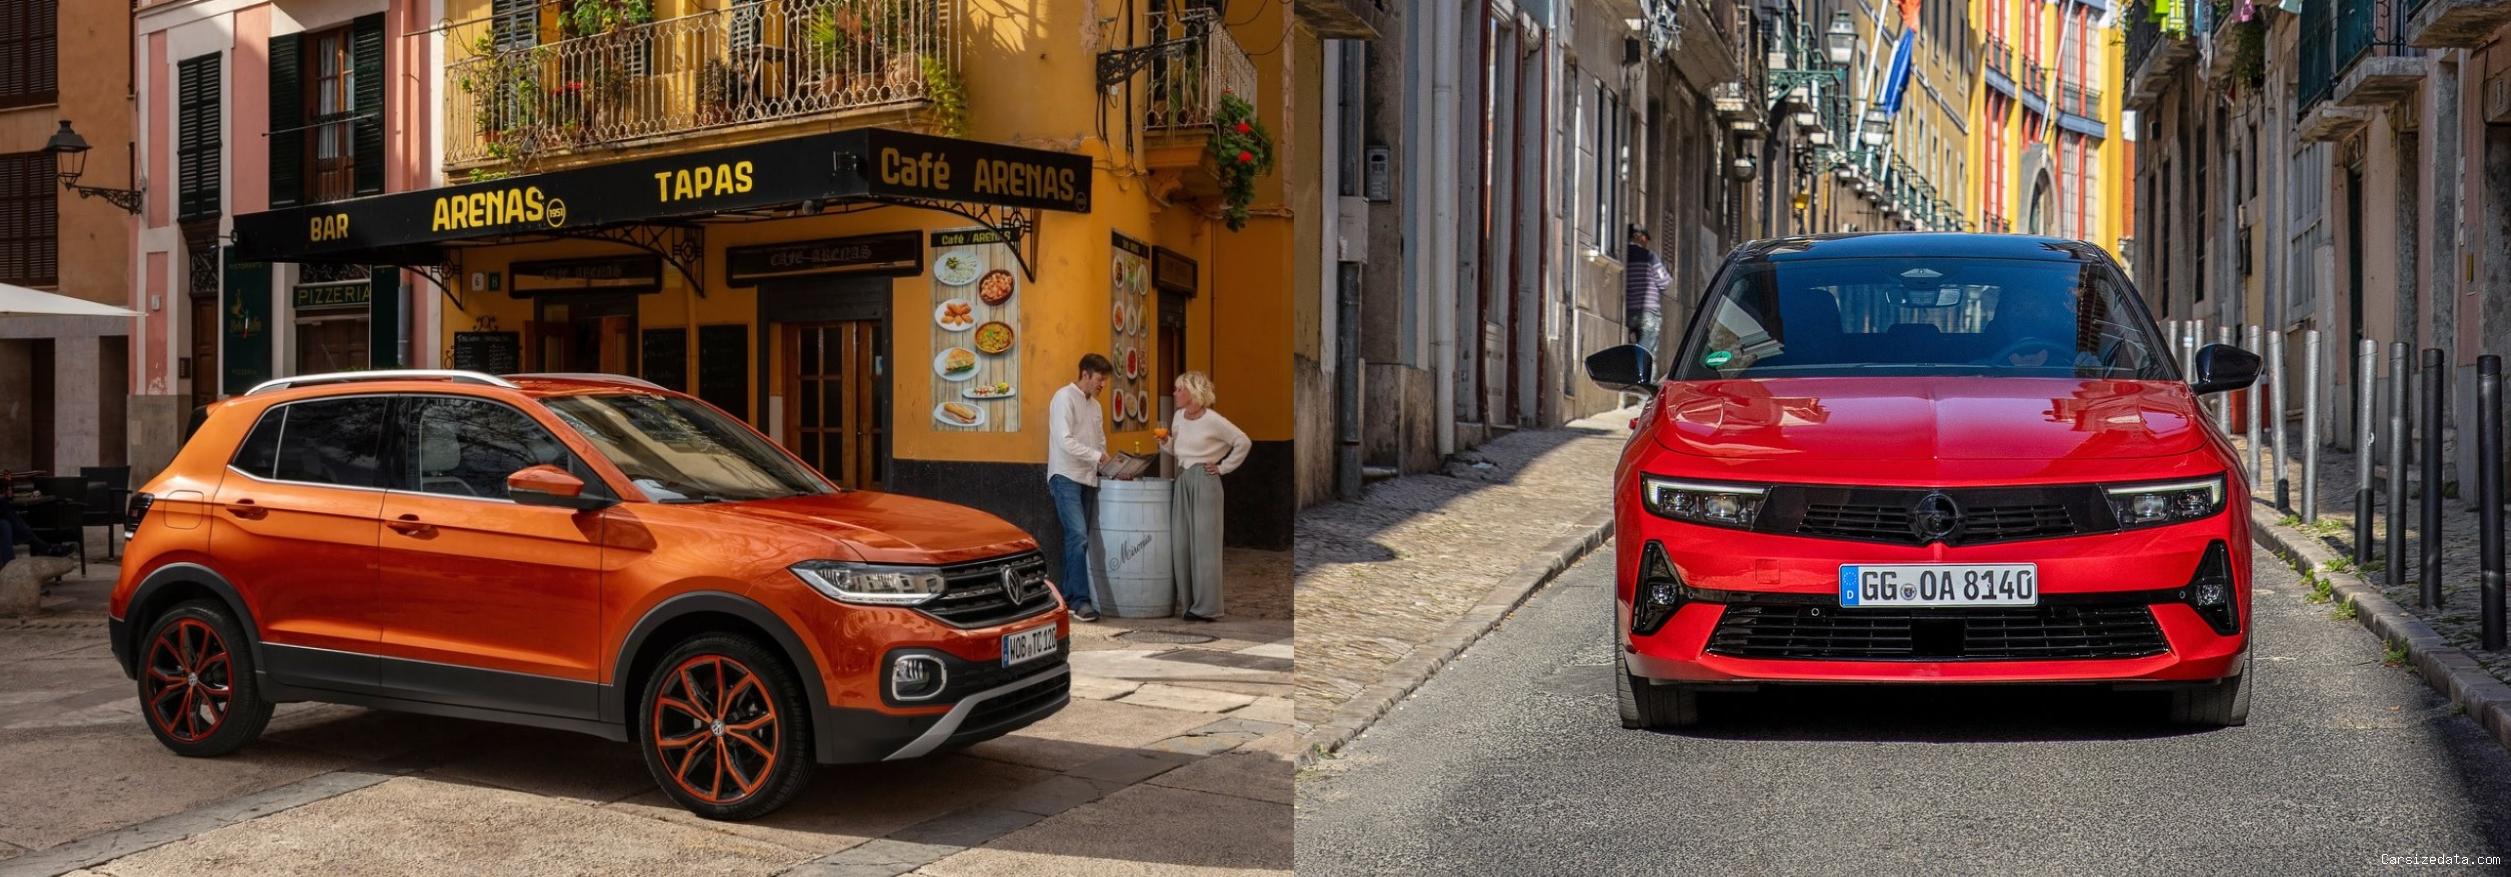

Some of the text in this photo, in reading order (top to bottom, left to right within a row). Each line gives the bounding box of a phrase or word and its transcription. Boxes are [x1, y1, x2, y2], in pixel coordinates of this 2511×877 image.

[654, 160, 753, 203] TAPAS
[881, 147, 950, 191] Café
[974, 158, 1075, 202] ARENAS
[432, 186, 544, 232] ARENAS
[310, 213, 349, 242] BAR
[941, 234, 964, 245] Café
[297, 286, 371, 304] PIZZERIA
[1846, 569, 2033, 601] D GG OA 8140
[1009, 635, 1027, 661] WOB
[1032, 631, 1042, 654] TC
